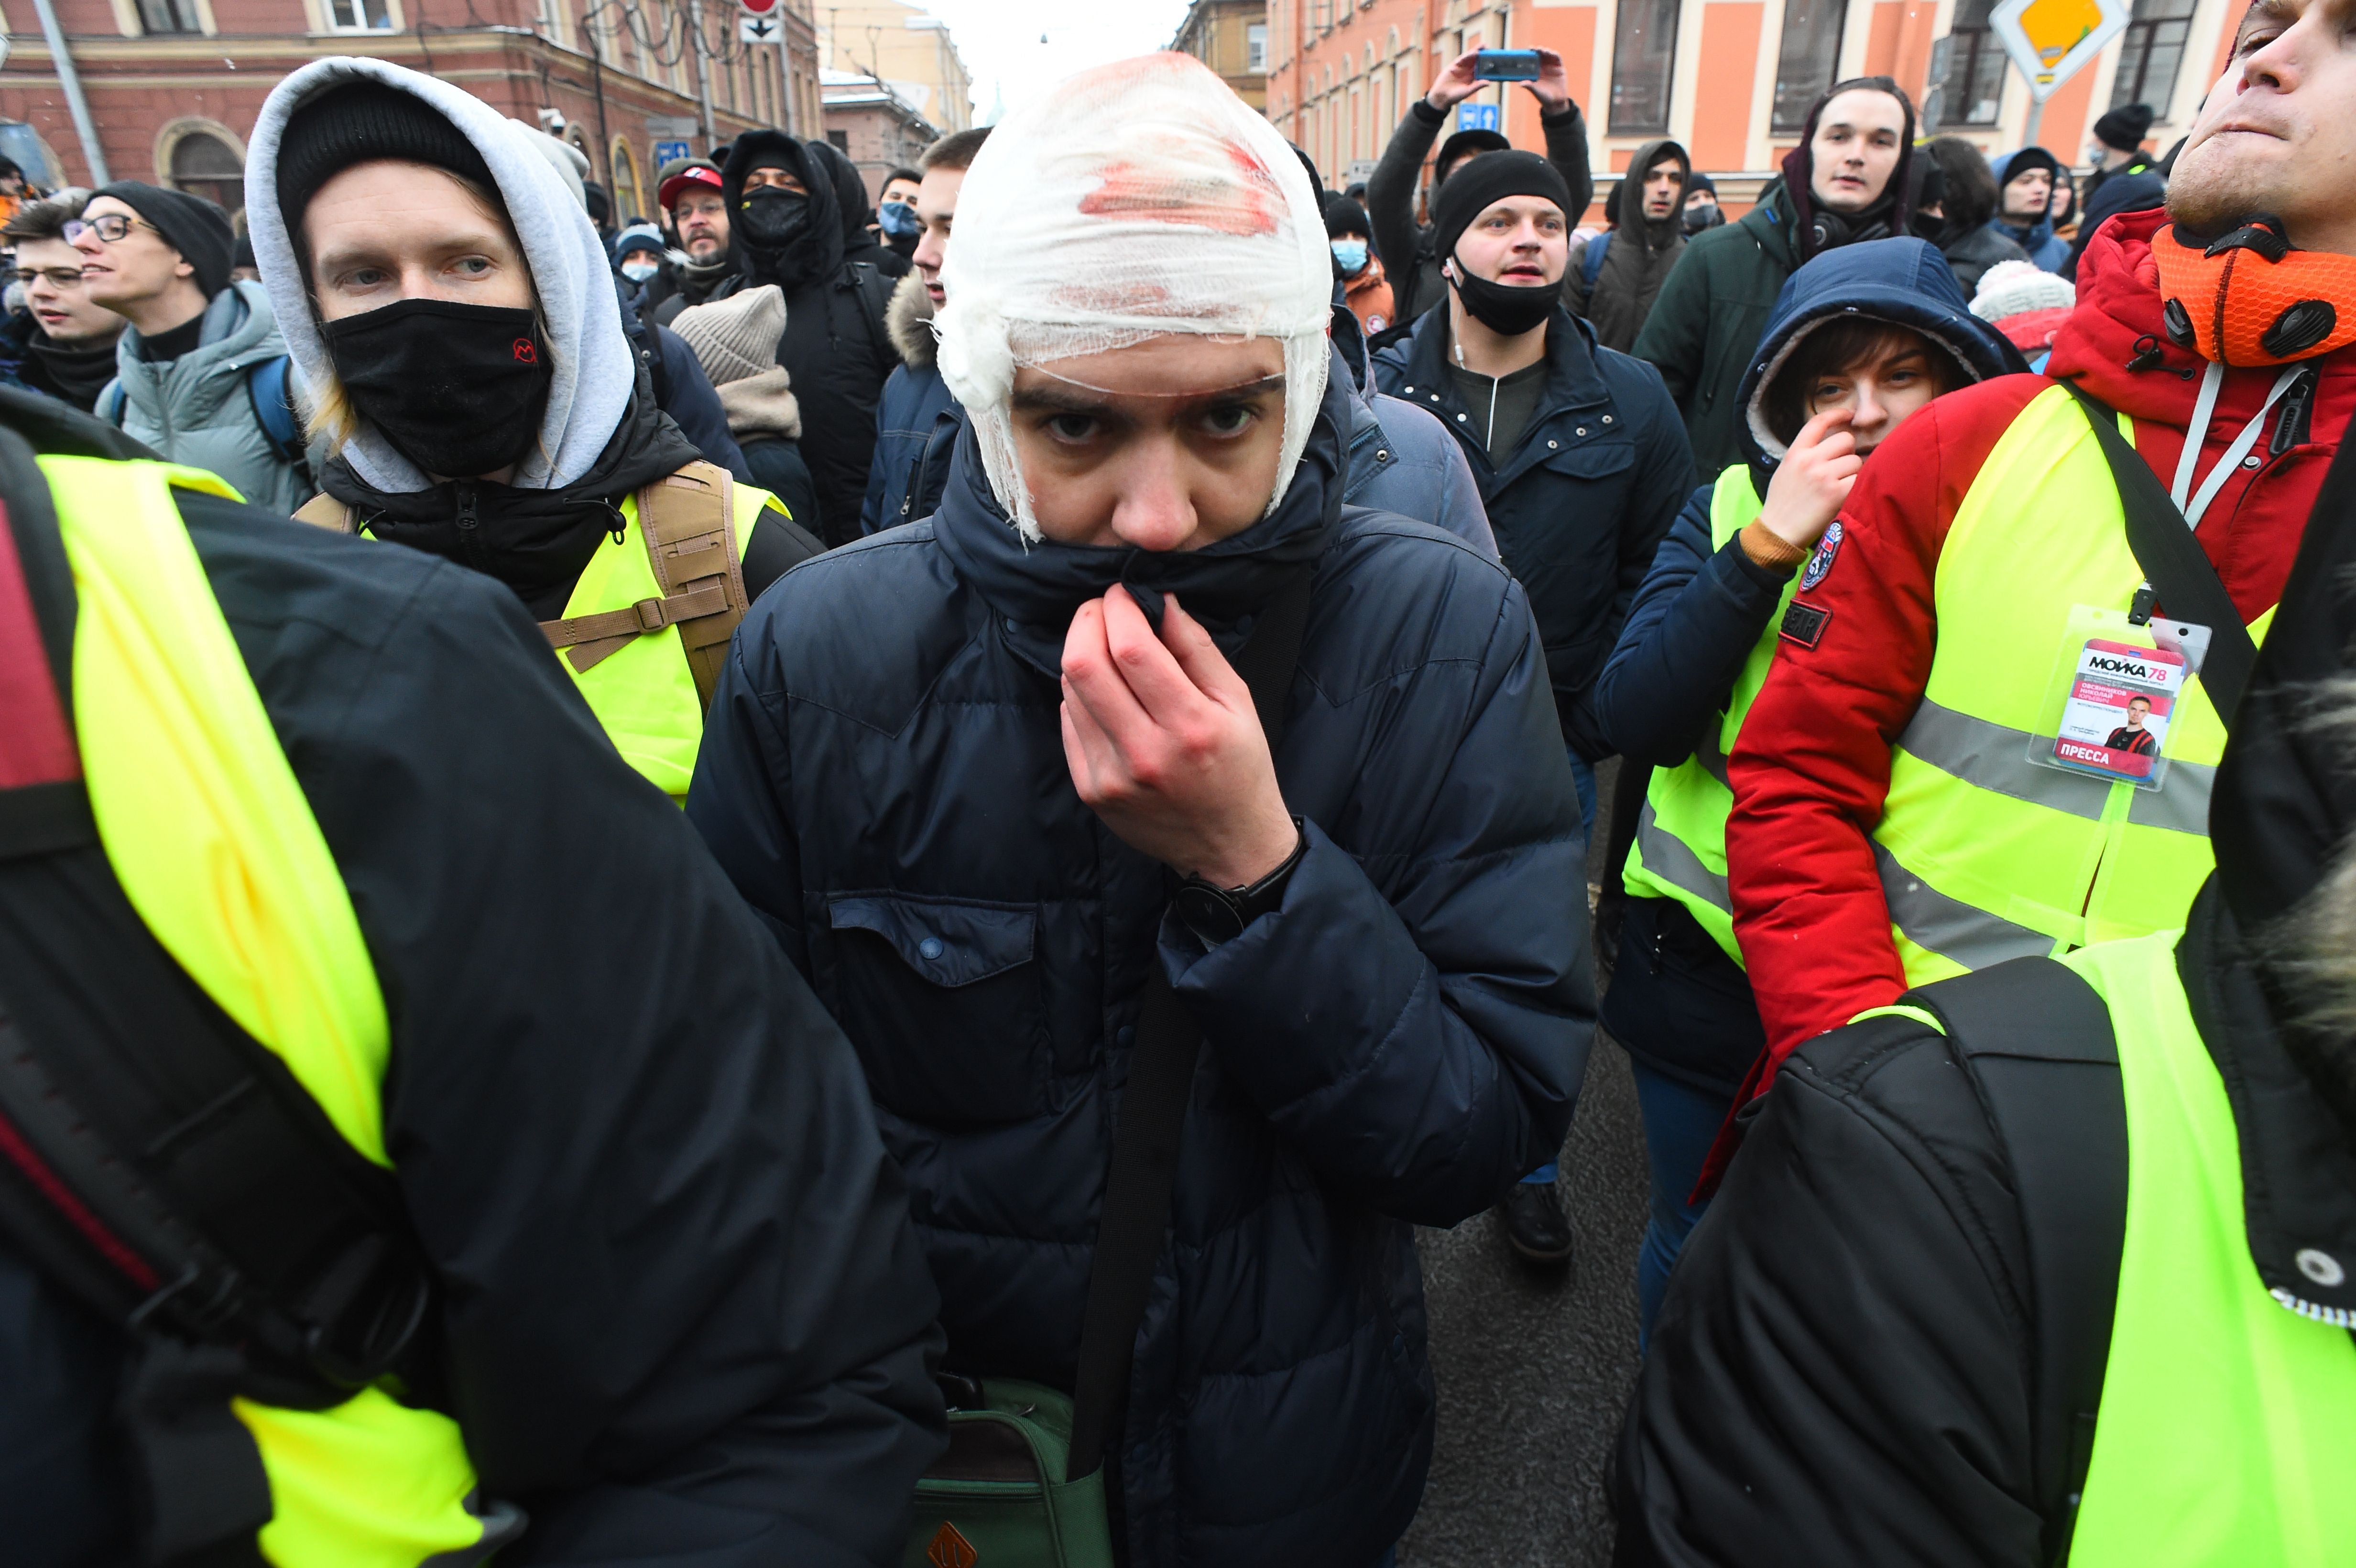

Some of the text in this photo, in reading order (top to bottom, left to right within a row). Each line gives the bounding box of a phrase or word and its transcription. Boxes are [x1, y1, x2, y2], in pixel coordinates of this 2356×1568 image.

[2089, 656, 2167, 681] МОЙКА 78
[2080, 688, 2113, 699] НИКОЛАЙ
[2082, 683, 2127, 696] ОВСЯННИКОВ
[2078, 693, 2110, 704] ЮРЬЕВИЧ
[2061, 743, 2109, 764] ПРЕССА
